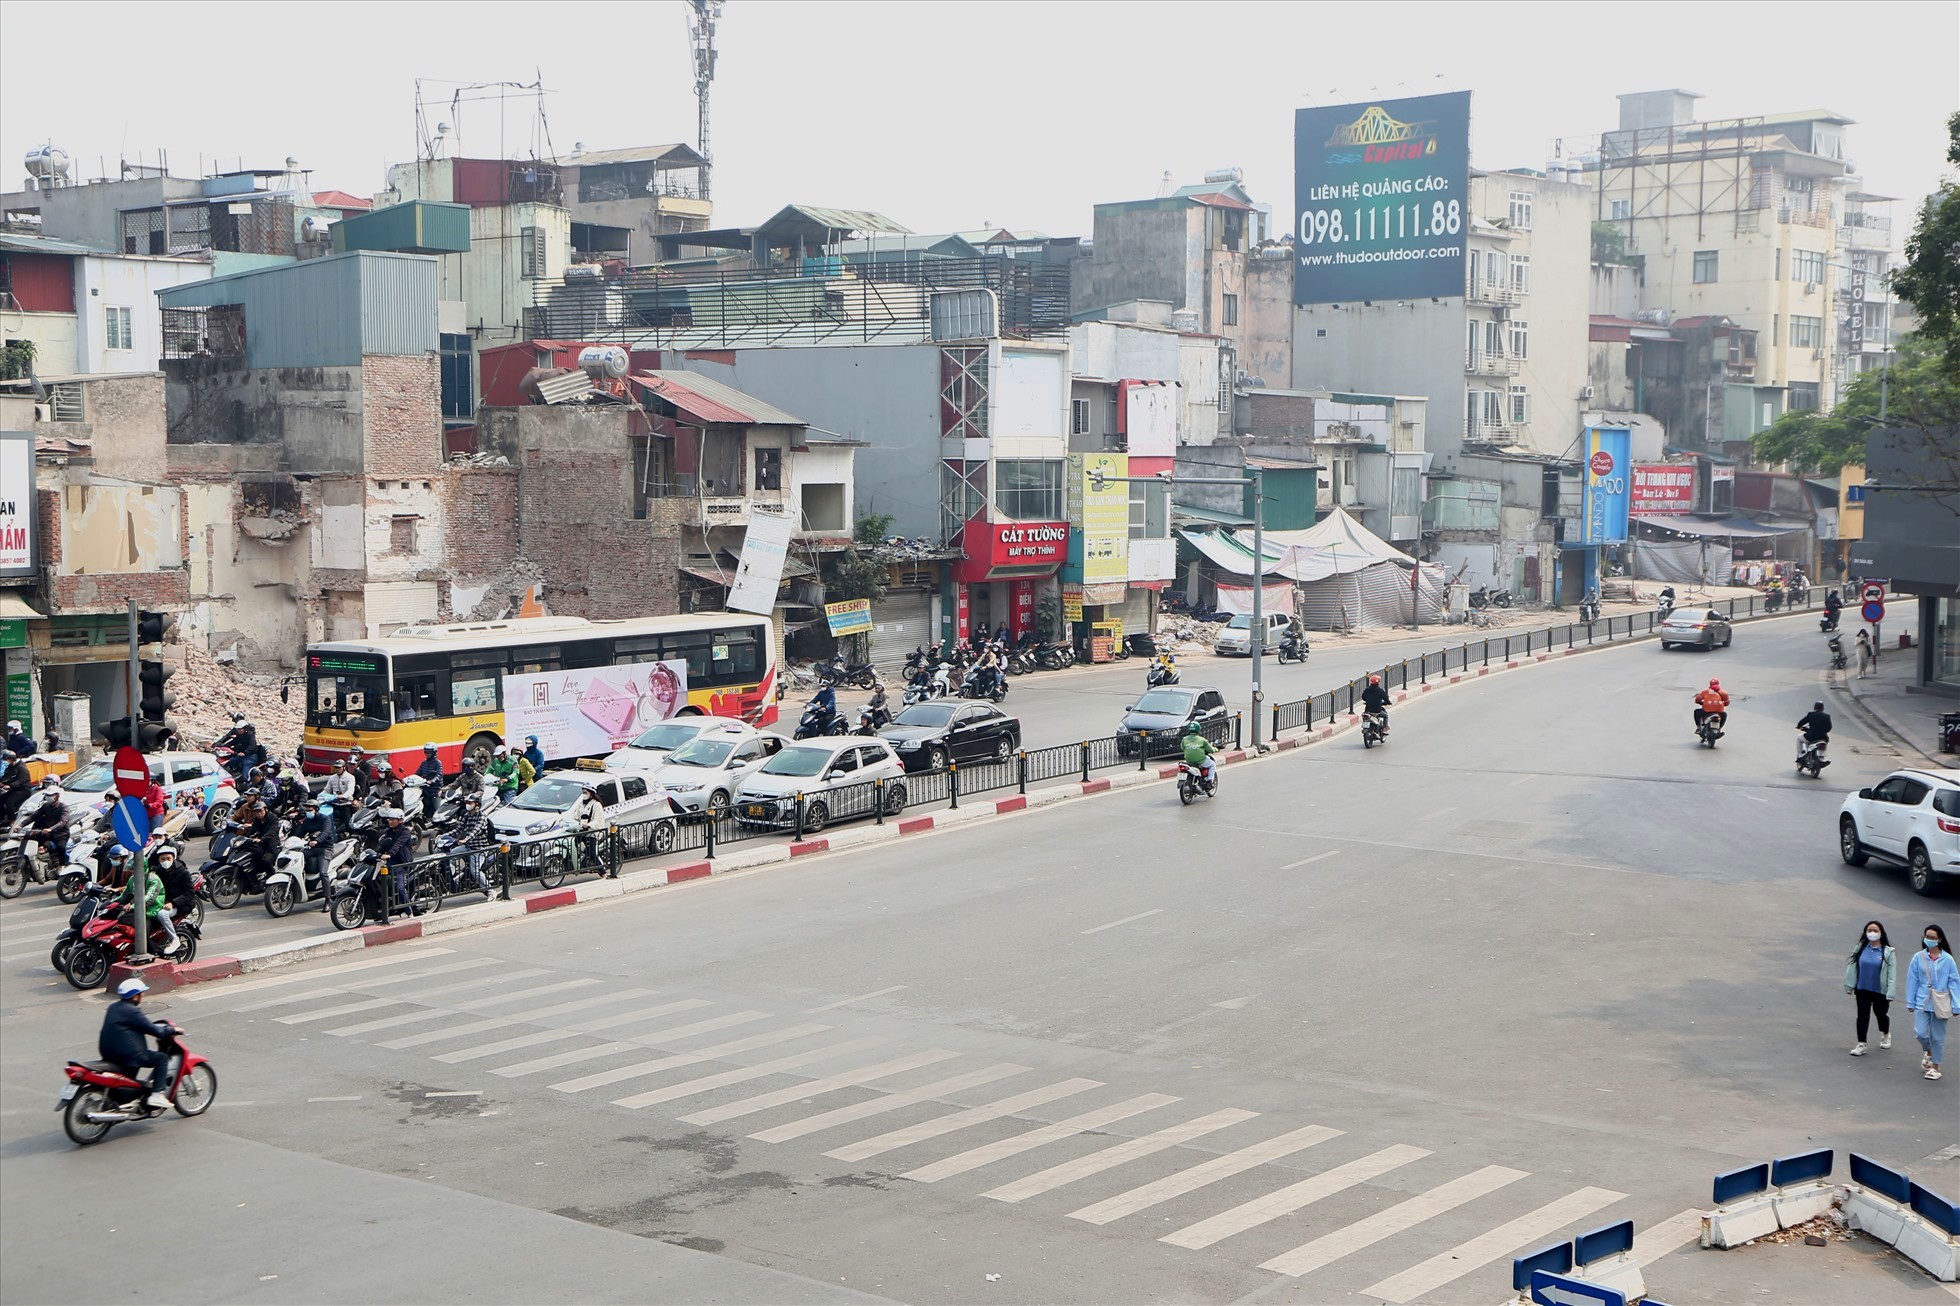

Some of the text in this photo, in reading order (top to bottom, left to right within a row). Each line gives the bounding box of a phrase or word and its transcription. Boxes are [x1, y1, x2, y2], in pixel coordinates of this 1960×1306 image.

[1364, 141, 1424, 165] Capital
[1311, 175, 1449, 201] LIÊN HỆ QUẢNG CÁO:
[1300, 199, 1461, 245] 098.11111.88
[1301, 245, 1460, 266] www.thudooutdoor.com
[1852, 274, 1864, 342] HOTEL
[1591, 461, 1611, 471] Couple
[1592, 455, 1611, 464] Choco
[1001, 525, 1065, 543] CÁT TƯỜNG
[1009, 546, 1022, 556] MÁY
[1023, 546, 1036, 557] TRỢ
[827, 600, 868, 615] FREE SHIP
